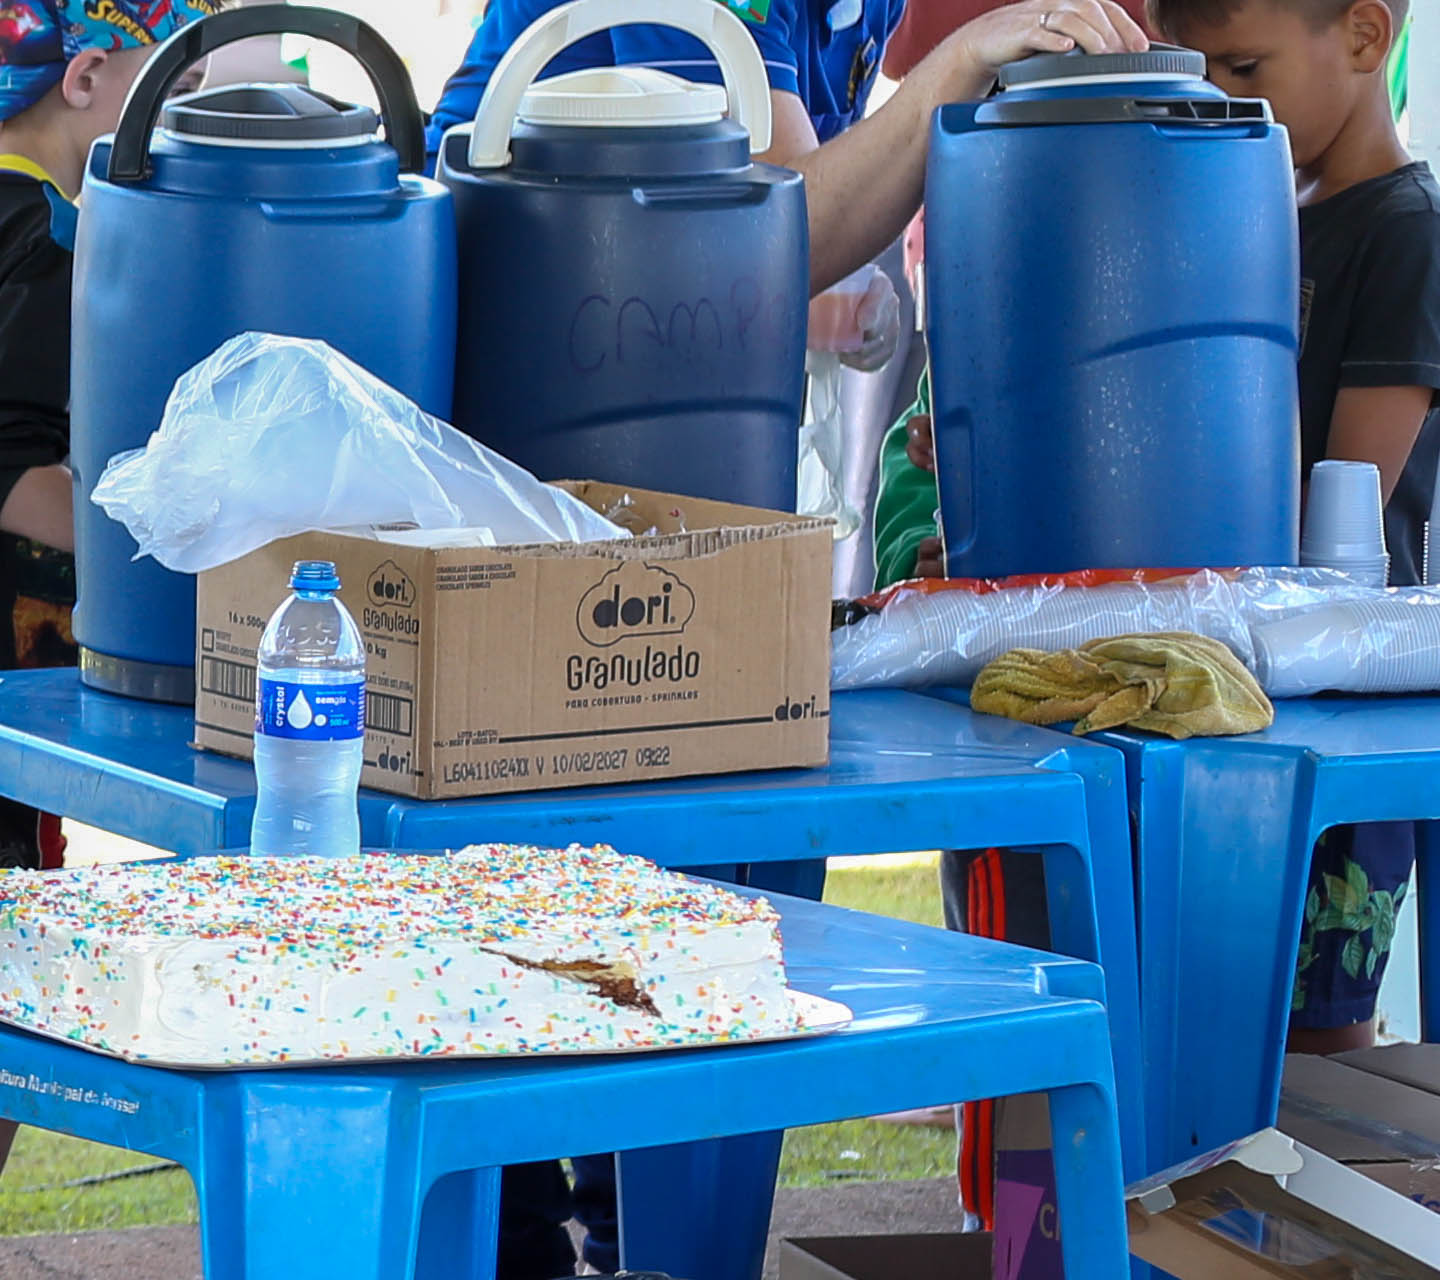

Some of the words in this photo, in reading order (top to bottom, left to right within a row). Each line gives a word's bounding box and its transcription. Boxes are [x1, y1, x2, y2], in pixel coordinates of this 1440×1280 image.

[363, 607, 420, 635] Granulado
[375, 643, 387, 659] kg
[566, 644, 701, 692] Granulado
[275, 686, 286, 727] crystal
[552, 748, 628, 775] 10/02/2027
